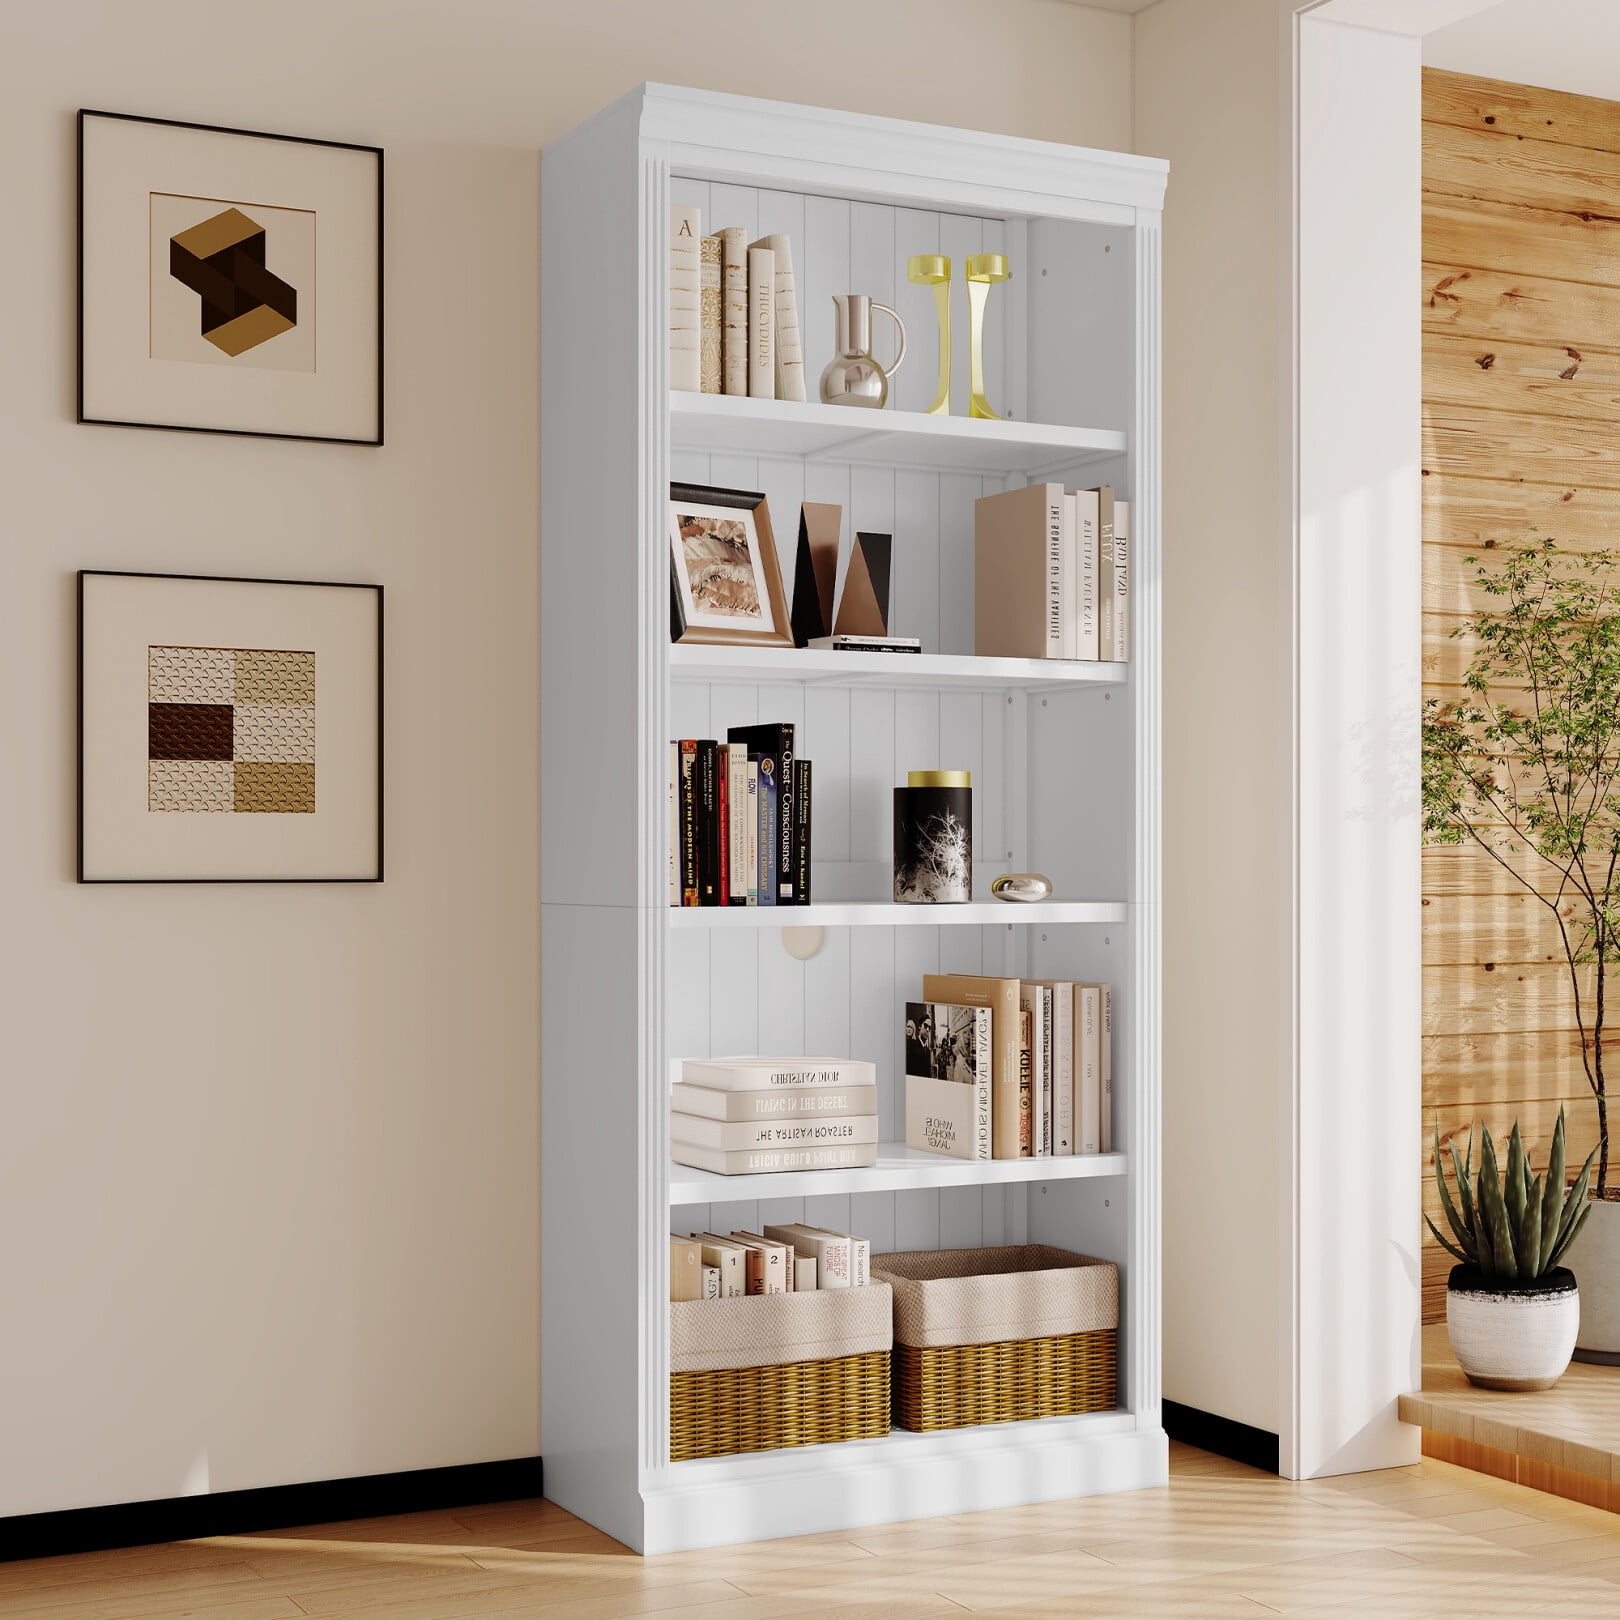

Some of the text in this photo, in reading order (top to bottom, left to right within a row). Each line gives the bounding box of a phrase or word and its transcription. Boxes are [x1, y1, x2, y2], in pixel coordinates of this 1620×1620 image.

[678, 219, 692, 237] A
[759, 283, 770, 368] THUCYDIDES
[782, 751, 793, 784] Quest
[748, 778, 756, 795] FLOW
[687, 792, 693, 804] OF
[800, 801, 809, 825] Memory
[782, 793, 793, 873] Consciousness
[731, 1257, 736, 1267] 1
[770, 1255, 779, 1265] 2
[857, 1245, 865, 1286] No search
